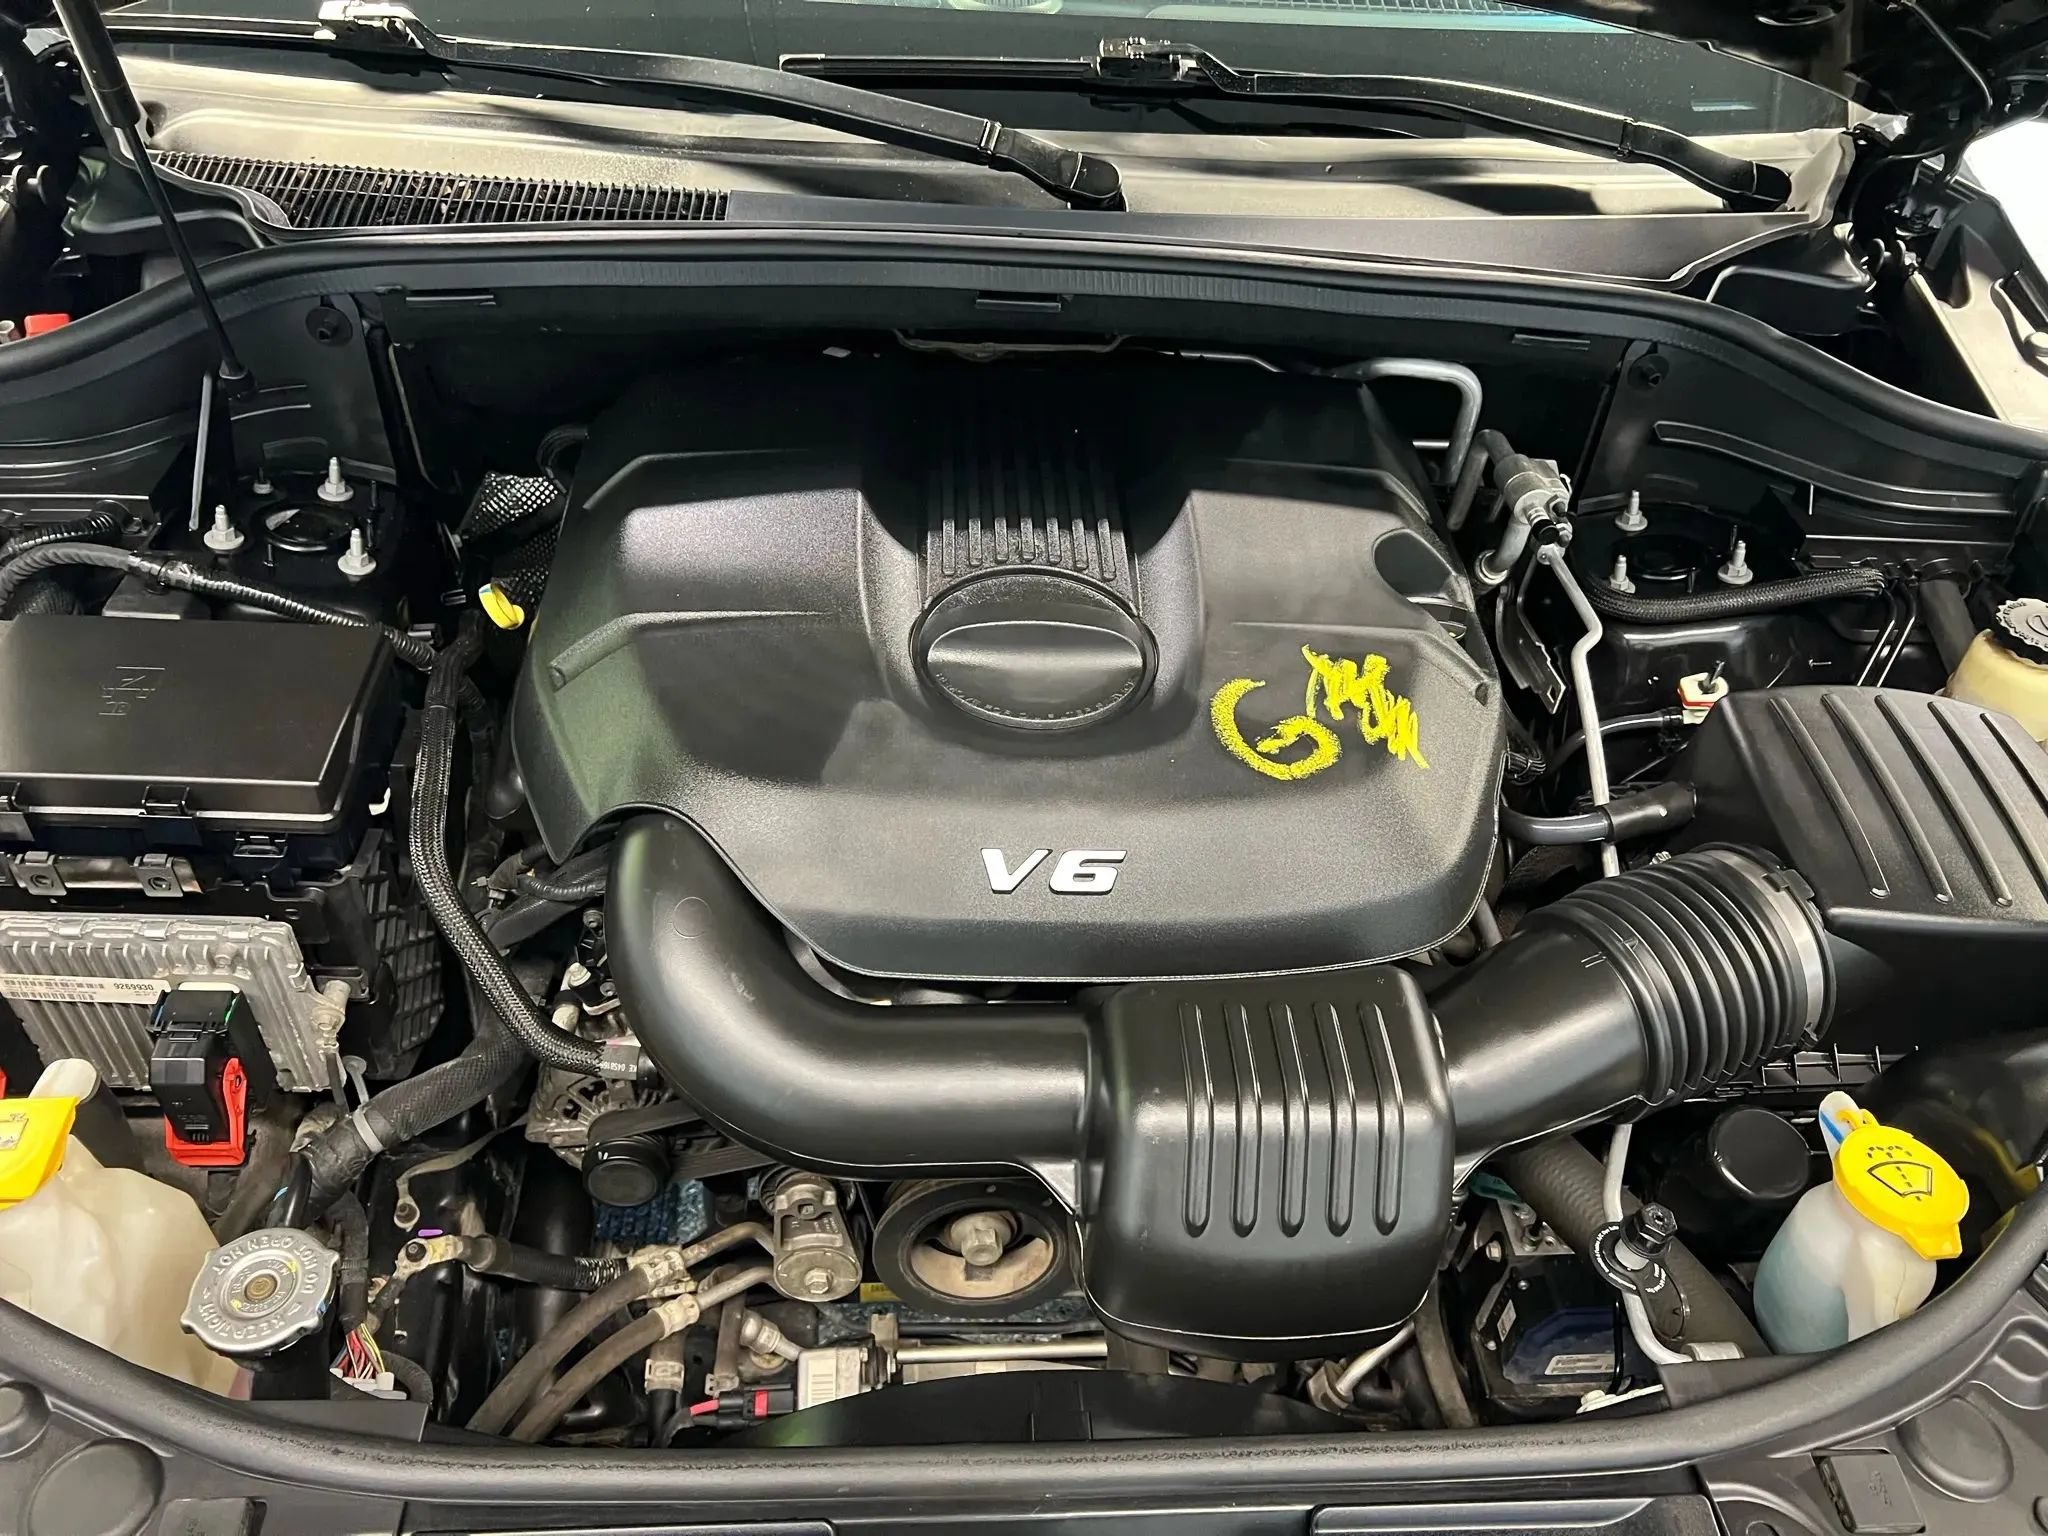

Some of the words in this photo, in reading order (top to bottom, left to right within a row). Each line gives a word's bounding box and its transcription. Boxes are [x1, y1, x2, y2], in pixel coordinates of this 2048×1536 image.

[980, 847, 1128, 896] V6
[247, 1235, 294, 1252] OPEN
[302, 1271, 319, 1294] DO
[199, 1302, 232, 1337] TIGHT
[233, 1314, 286, 1340] KEEP
